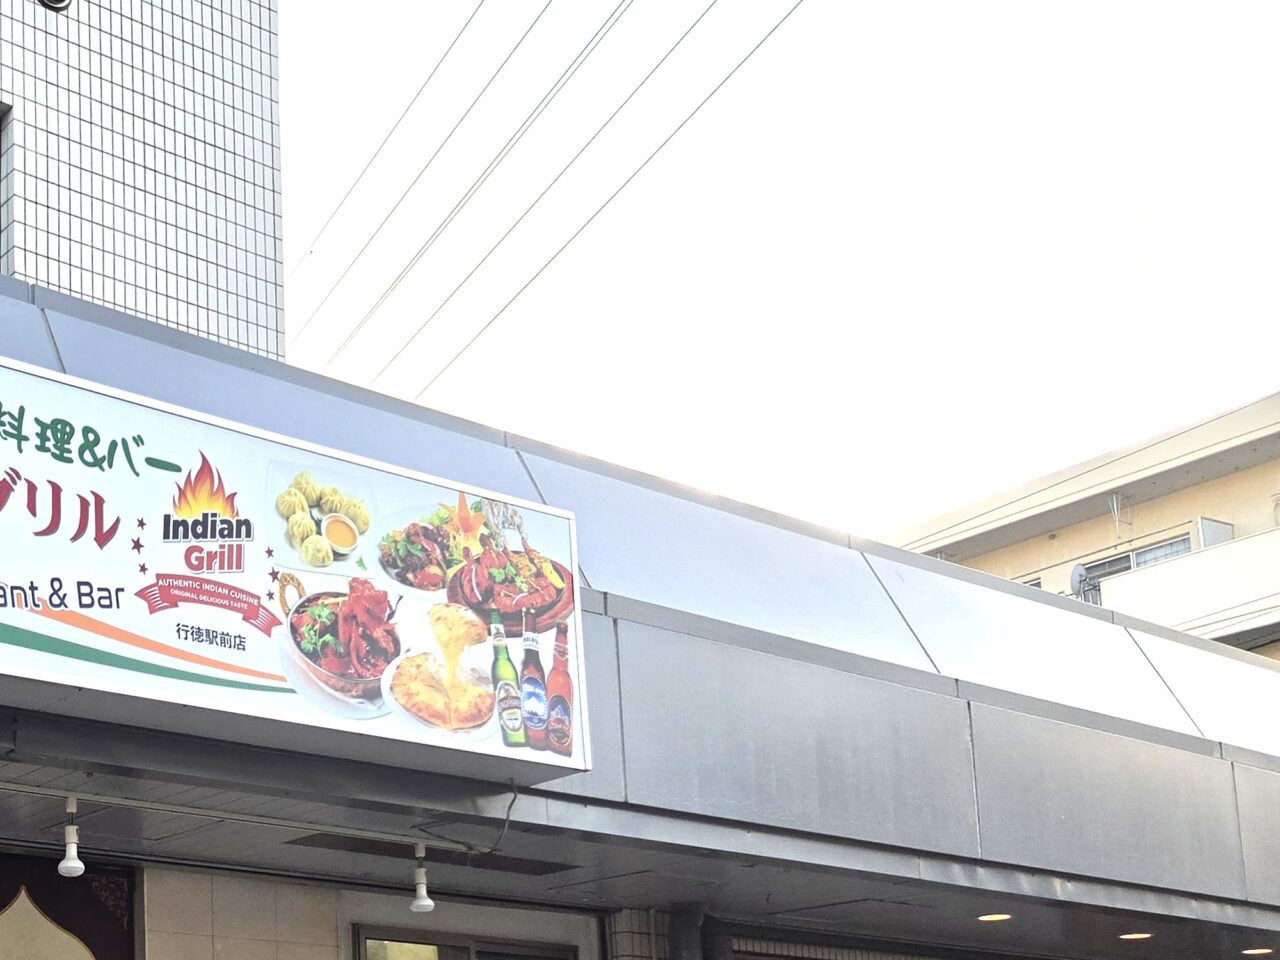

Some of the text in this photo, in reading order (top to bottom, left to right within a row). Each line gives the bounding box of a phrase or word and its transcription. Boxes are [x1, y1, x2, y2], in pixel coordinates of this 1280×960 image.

[162, 512, 253, 541] Indian
[184, 543, 243, 572] Grill
[49, 577, 71, 609] &
[78, 580, 125, 610] Bar
[158, 578, 259, 606] AUTHENTIC INDIAN CUISINE
[170, 588, 249, 610] ORIGINAL DELICIOUS TASTE
[176, 622, 247, 652] 行徳駅前店
